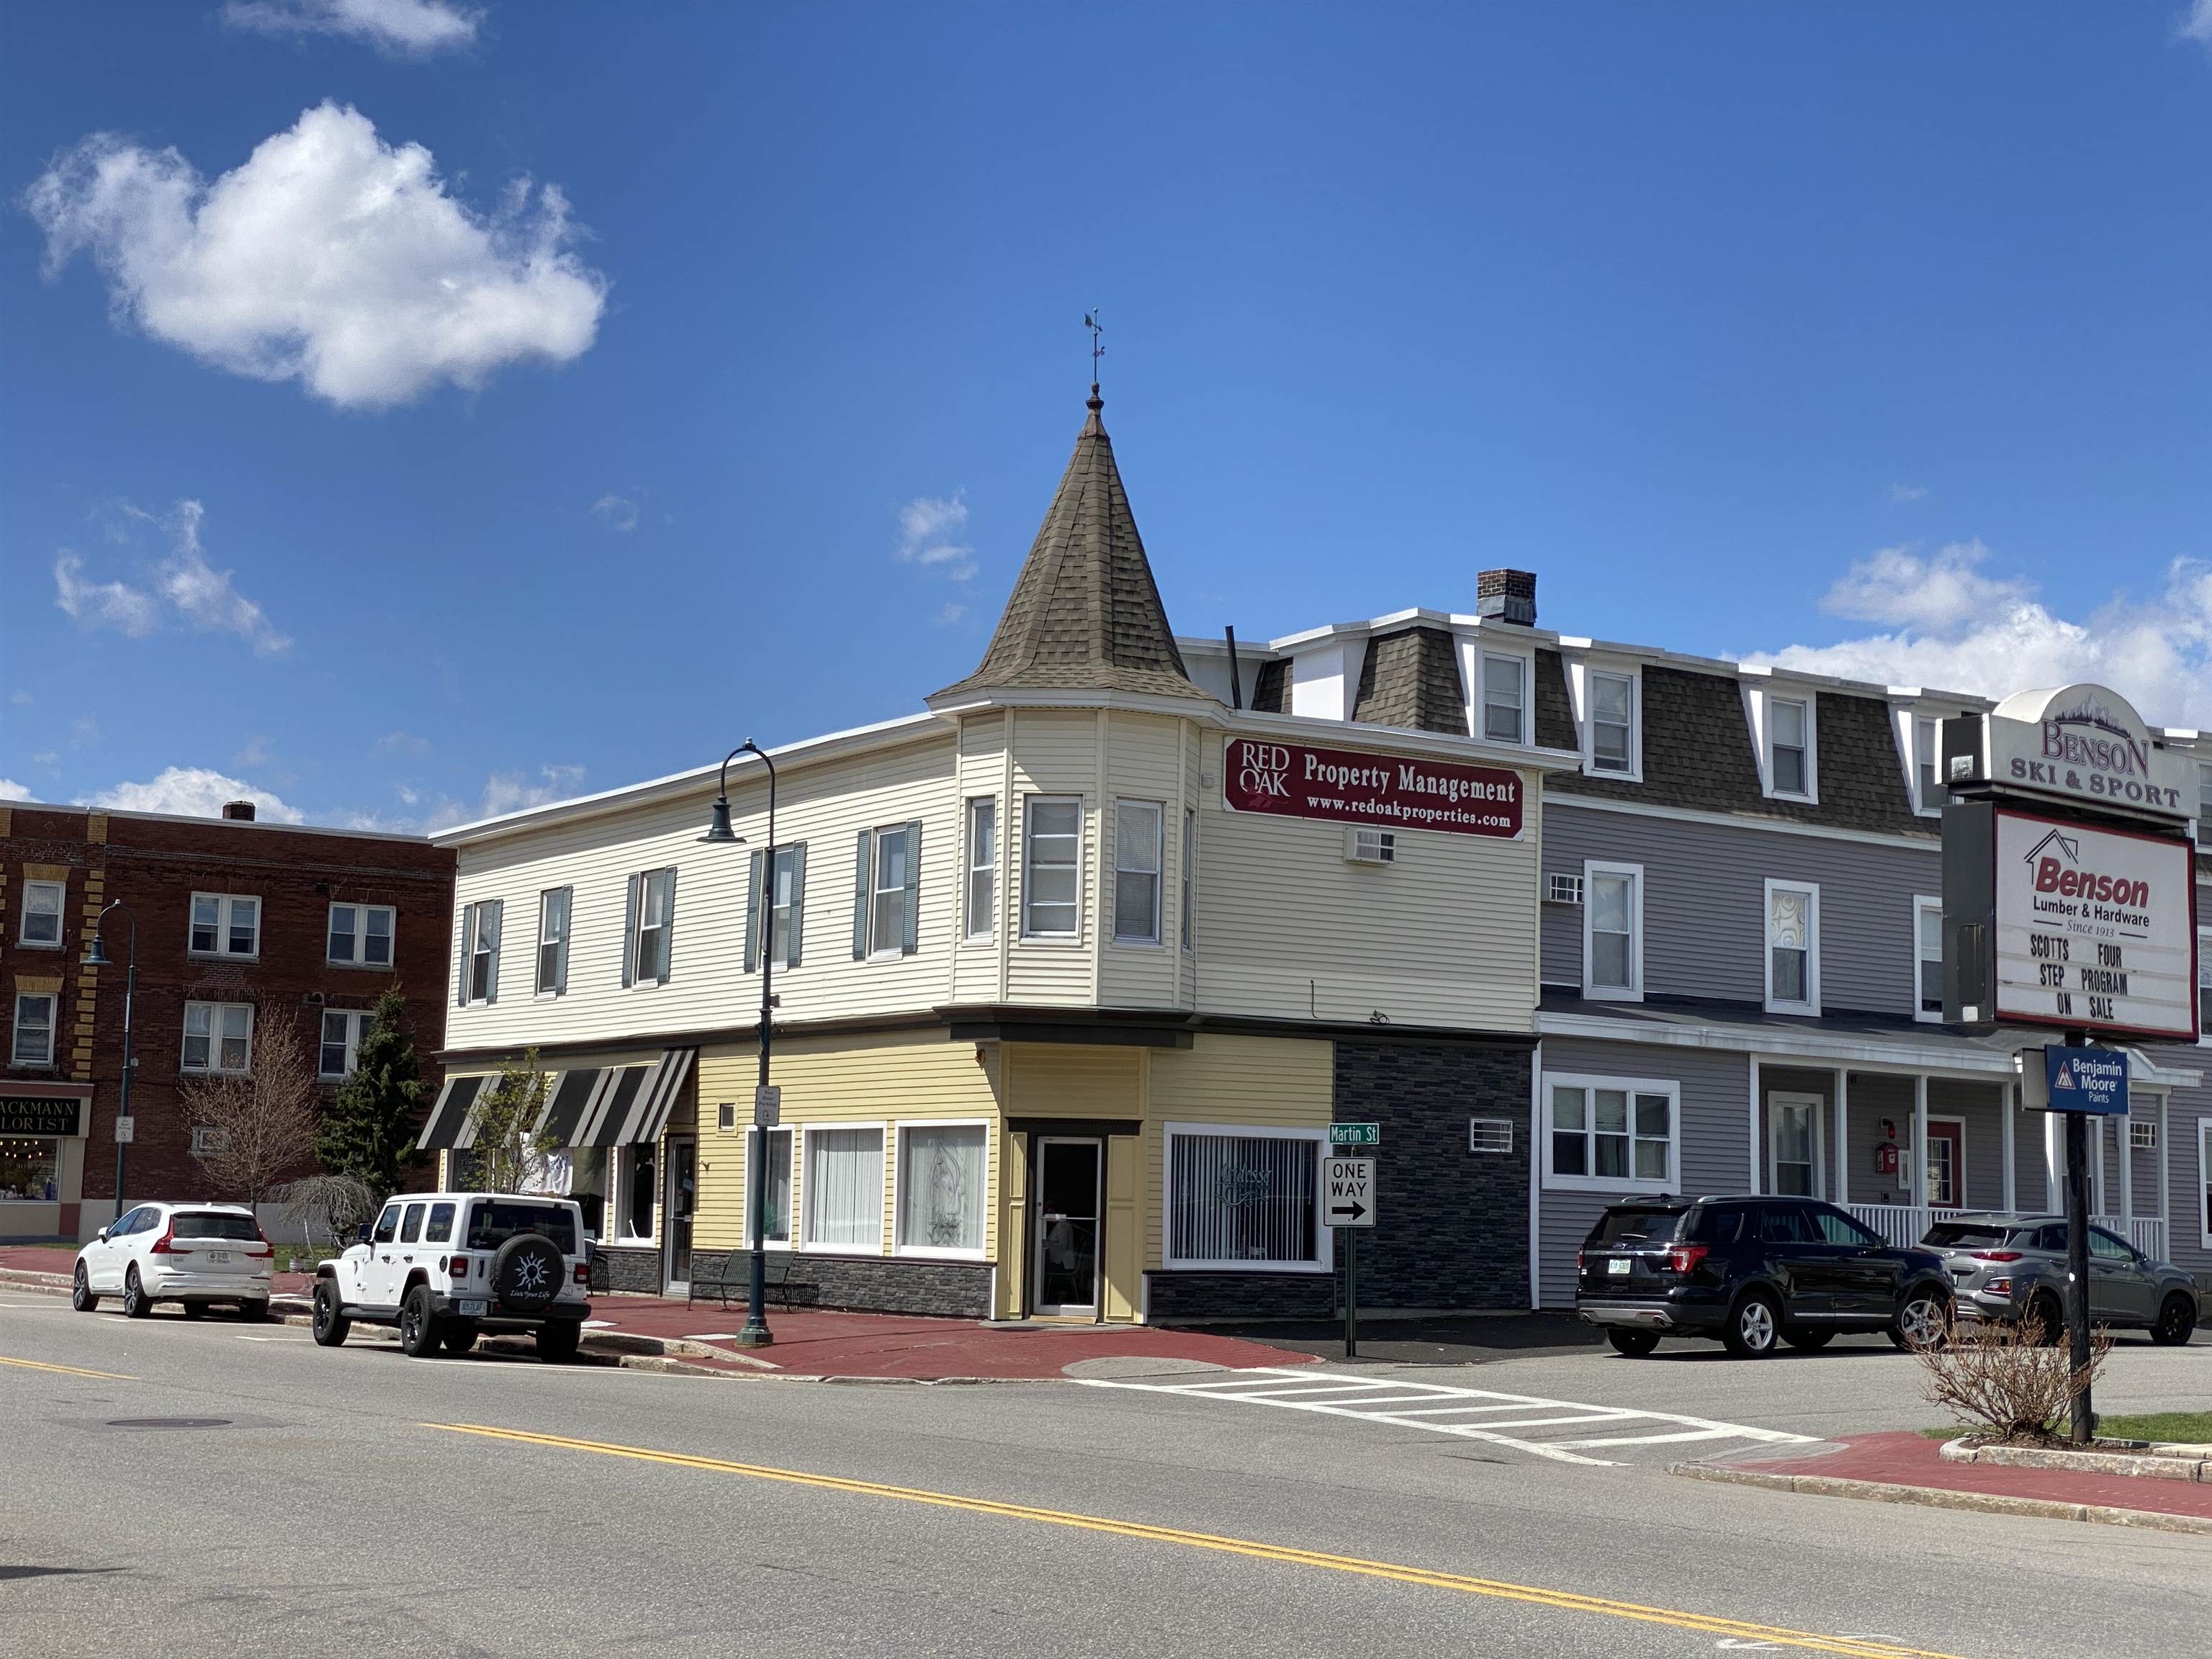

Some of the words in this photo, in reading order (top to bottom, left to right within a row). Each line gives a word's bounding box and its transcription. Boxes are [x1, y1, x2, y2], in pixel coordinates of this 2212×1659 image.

[1241, 742, 1290, 773] RED
[2041, 721, 2149, 779] BENSON
[1239, 768, 1291, 797] OAK
[1304, 754, 1390, 794] Property
[1398, 765, 1515, 803] Management
[2010, 757, 2057, 785] SKI
[2065, 770, 2082, 790] &
[2090, 774, 2180, 808] SPORT
[1307, 796, 1511, 827] www.redoakproperties.com
[2036, 856, 2149, 908] Benson
[2033, 895, 2078, 916] Lumber
[2082, 903, 2090, 918] &
[2094, 904, 2149, 927] Hardware
[2067, 920, 2092, 934] Since
[2096, 927, 2114, 937] 1913
[2031, 934, 2069, 961] SCOTTS
[2098, 943, 2122, 968] FOUR
[2040, 963, 2064, 987] STEP
[2081, 968, 2128, 996] PROGRAM
[2057, 992, 2072, 1015] ON
[2090, 996, 2114, 1020] SALE
[2072, 1058, 2122, 1077] Benjamin
[2081, 1075, 2116, 1092] Moore
[2088, 1091, 2109, 1103] Paints
[1, 1117, 68, 1130] LORIST
[1331, 1126, 1361, 1141] Martin
[1367, 1126, 1377, 1141] St
[1333, 1163, 1367, 1179] ONE
[1331, 1182, 1367, 1197] WAY
